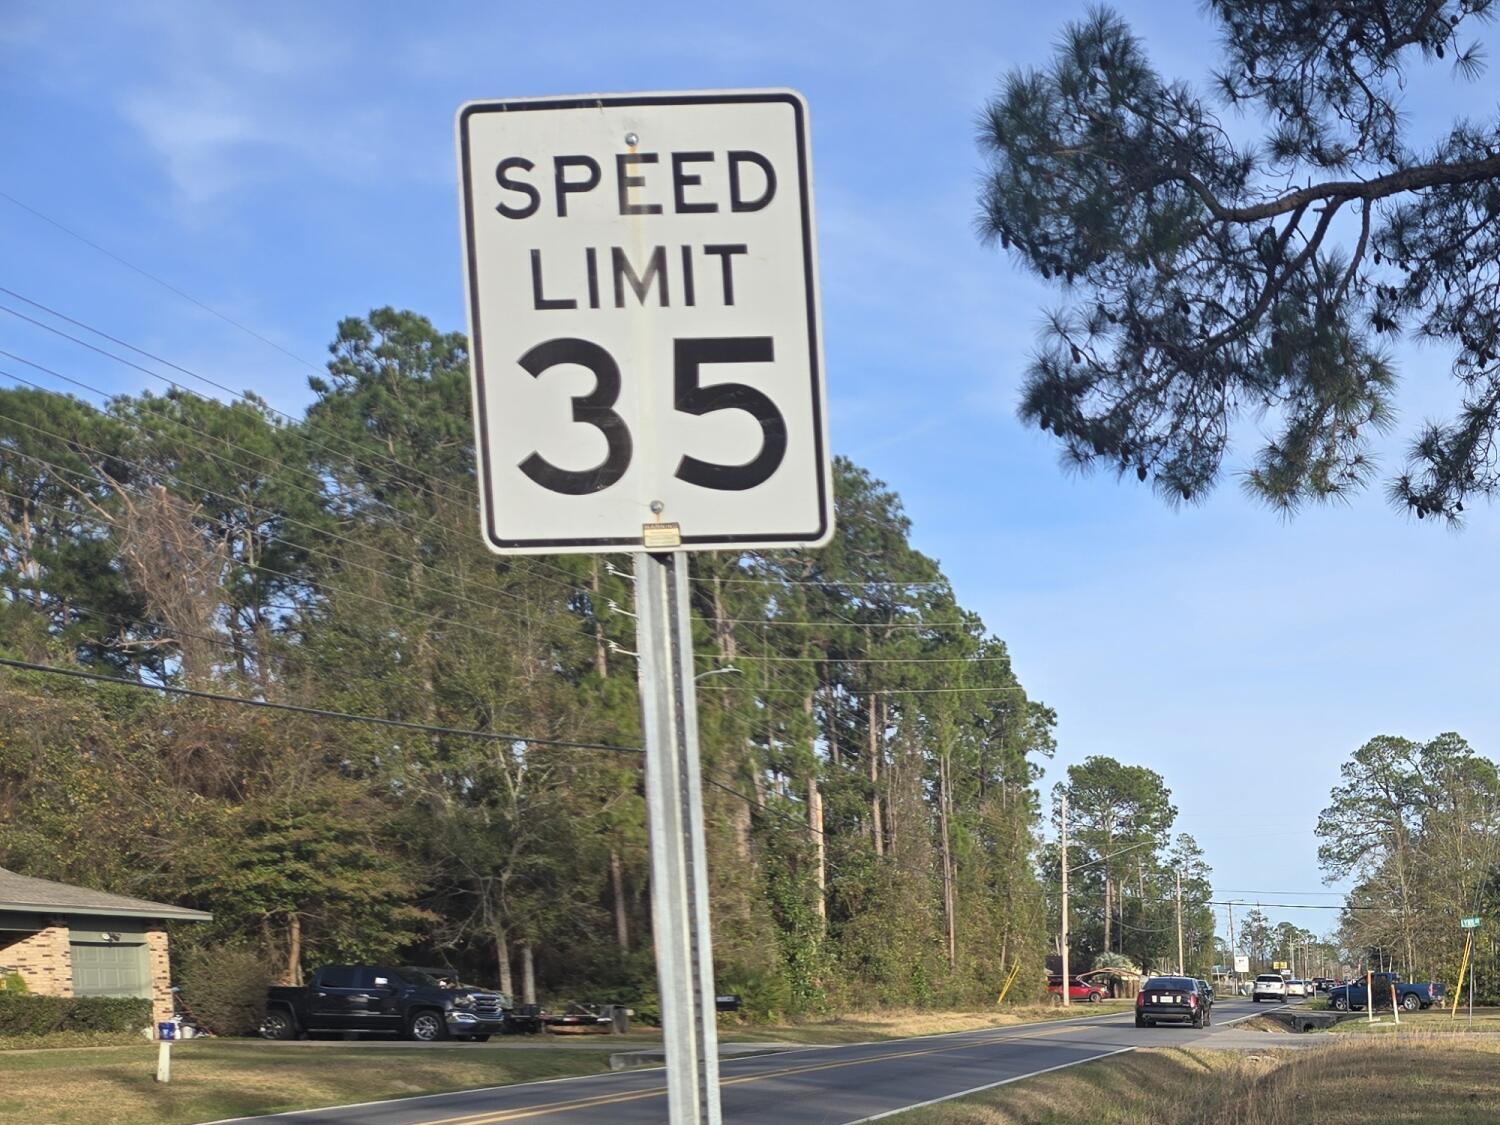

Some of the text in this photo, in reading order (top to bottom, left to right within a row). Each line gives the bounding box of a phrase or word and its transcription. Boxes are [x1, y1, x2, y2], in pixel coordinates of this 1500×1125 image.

[495, 150, 777, 220] SPEED
[530, 244, 748, 310] LIMIT
[516, 336, 788, 496] 35
